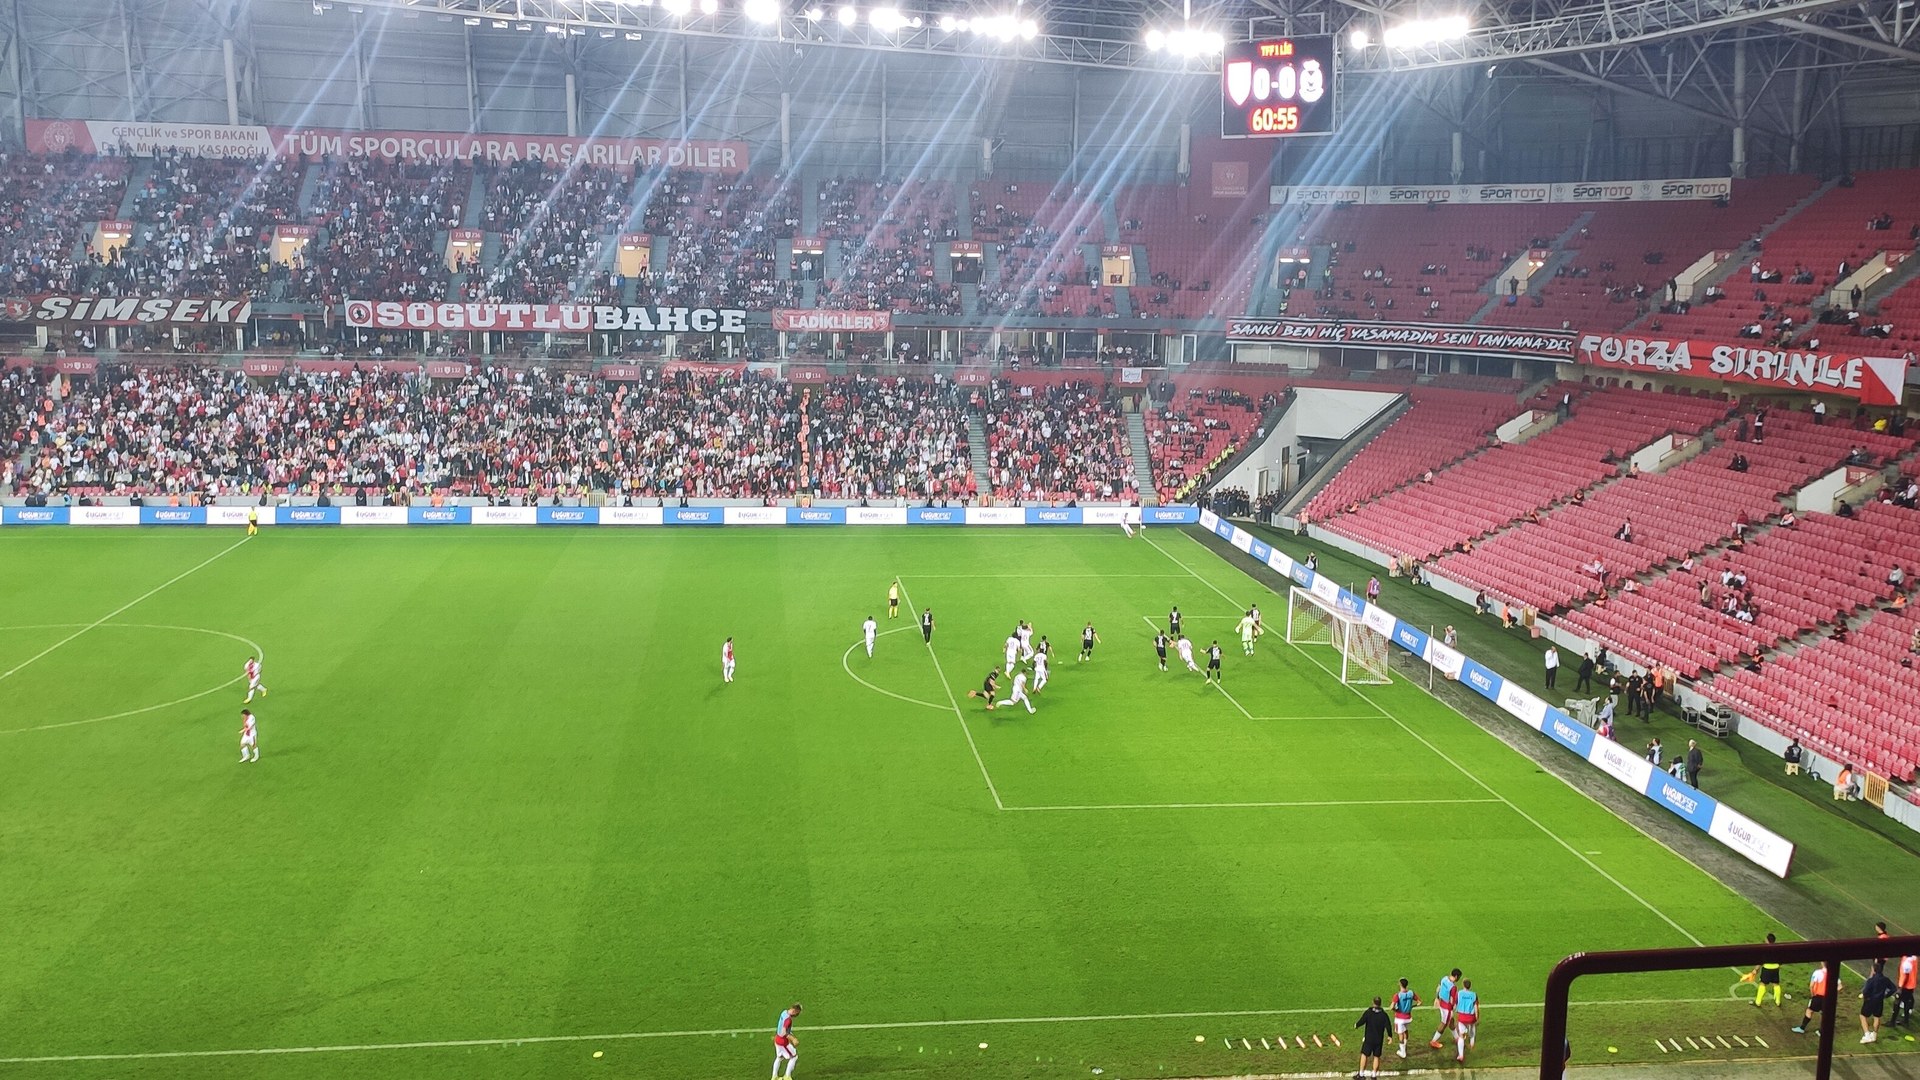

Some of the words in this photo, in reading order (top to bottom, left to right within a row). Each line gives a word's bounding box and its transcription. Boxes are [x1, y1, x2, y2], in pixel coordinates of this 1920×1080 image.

[1252, 107, 1298, 131] 60:55
[112, 126, 162, 140] GENÇLİK
[164, 130, 178, 138] ve
[180, 128, 212, 139] SPOR
[214, 130, 258, 141] BAKANI
[284, 130, 342, 156] TÜM
[669, 142, 736, 168] DİLER
[789, 313, 874, 329] LADİKLİLER
[1230, 322, 1281, 335] SANKİ
[1281, 325, 1318, 338] BEN
[1318, 324, 1346, 342] HİÇ
[1438, 330, 1476, 345] SENİ
[1580, 335, 1692, 372] FORZA
